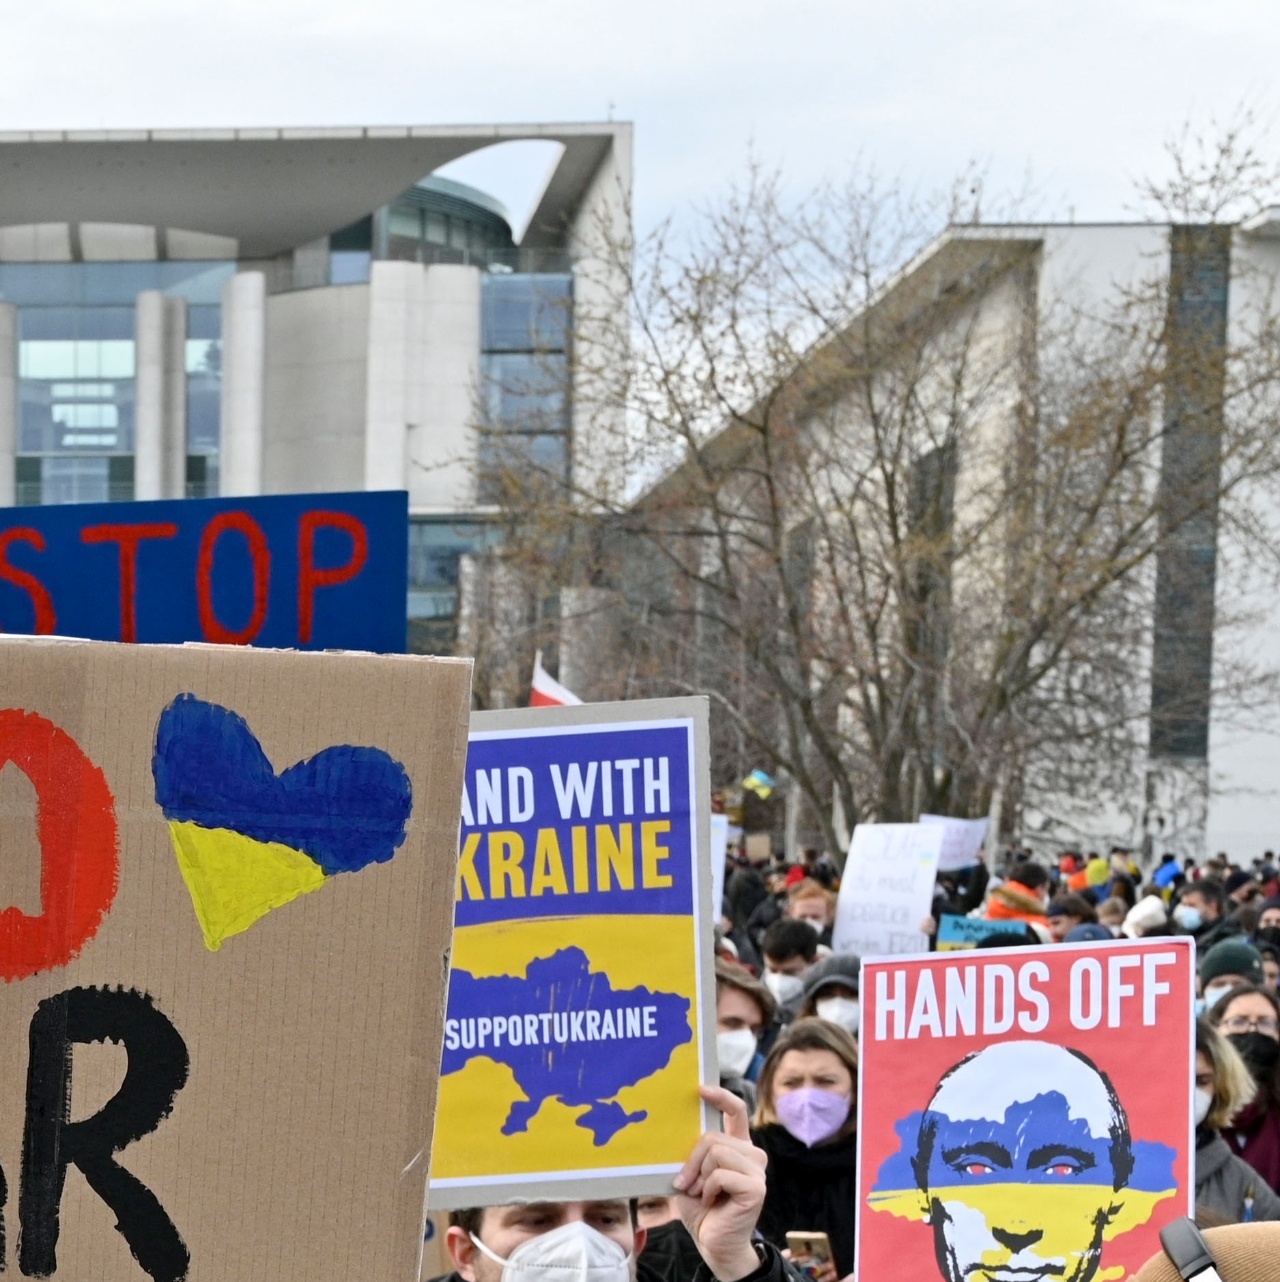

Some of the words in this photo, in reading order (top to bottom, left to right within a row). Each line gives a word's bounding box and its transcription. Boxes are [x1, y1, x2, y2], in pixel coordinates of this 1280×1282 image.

[549, 757, 670, 820] WITH
[875, 961, 1050, 1040] HANDS
[1069, 952, 1177, 1031] OFF
[445, 1006, 658, 1050] SUPPORTUKRAINE
